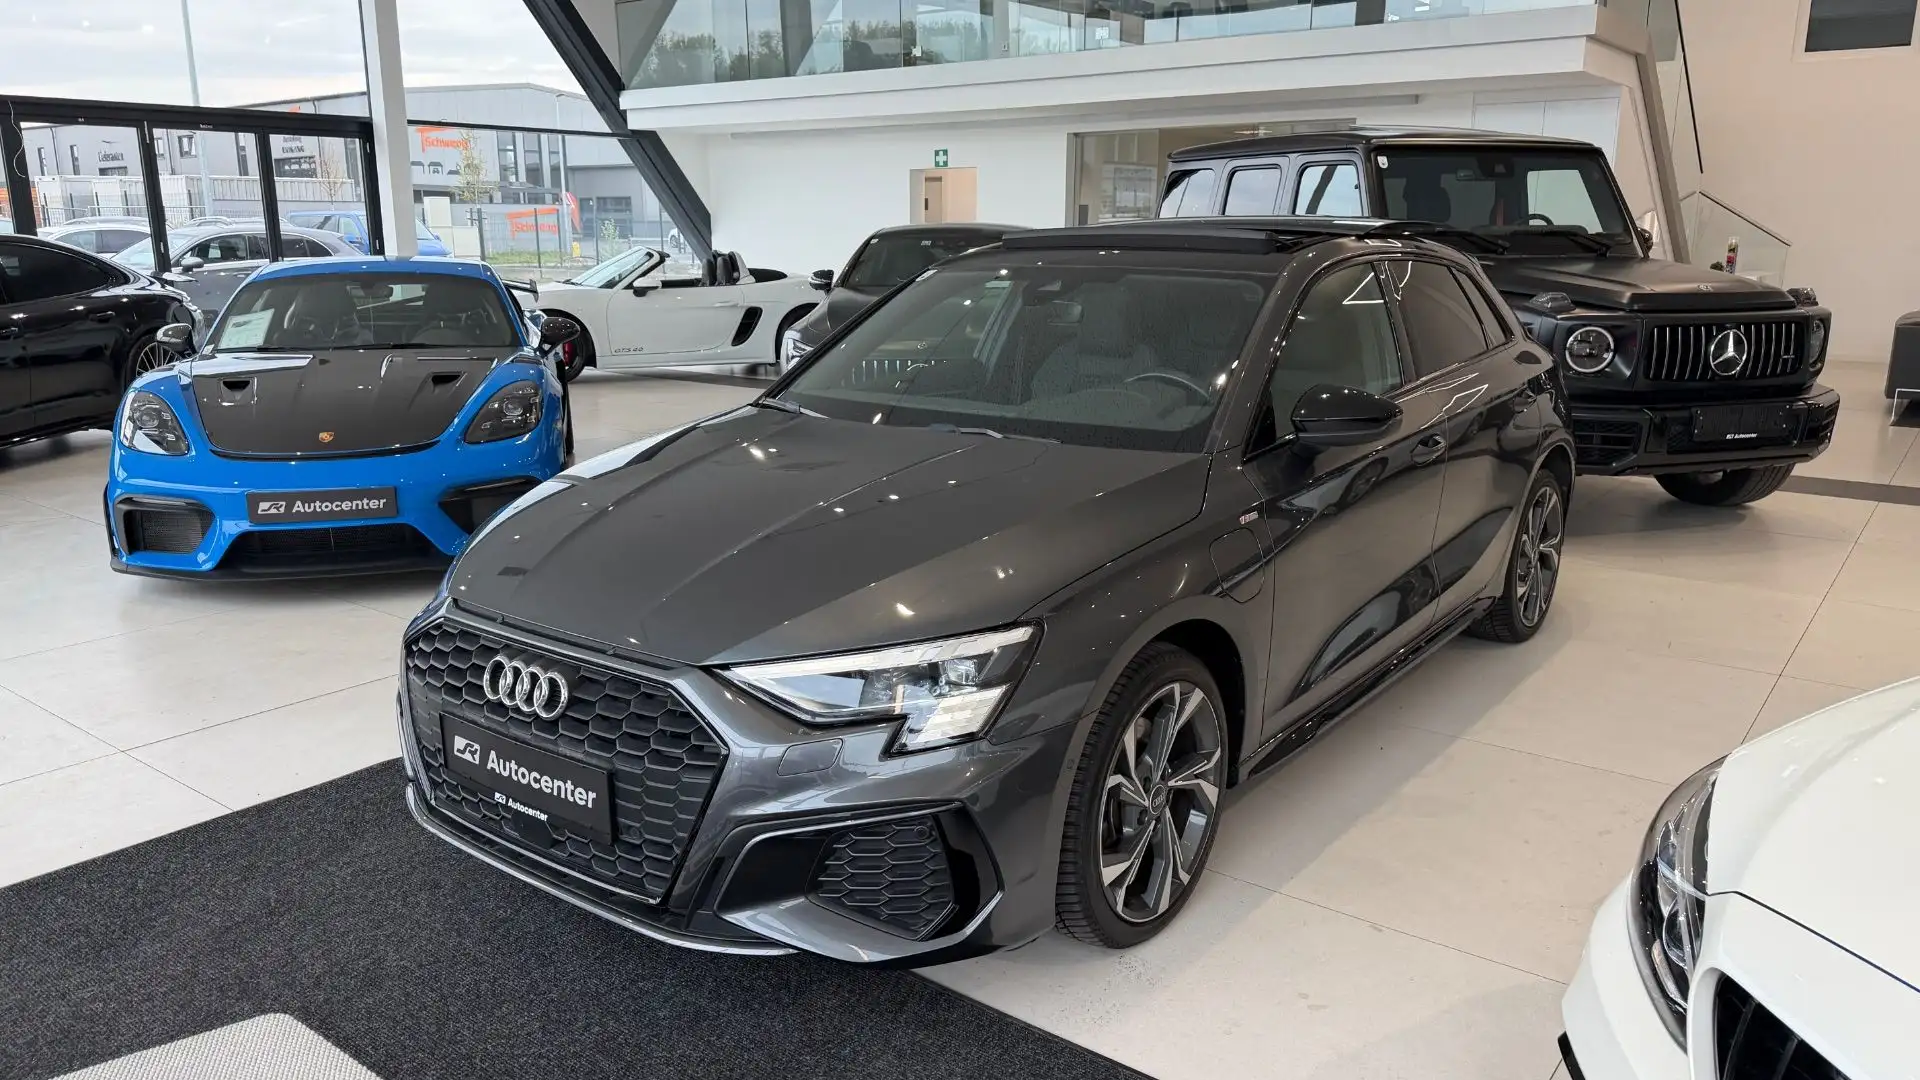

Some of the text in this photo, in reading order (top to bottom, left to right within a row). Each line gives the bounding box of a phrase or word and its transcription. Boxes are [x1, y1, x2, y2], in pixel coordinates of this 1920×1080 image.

[292, 498, 387, 513] Autocenter
[486, 750, 597, 809] Autocenter
[507, 798, 548, 822] Autocenter
